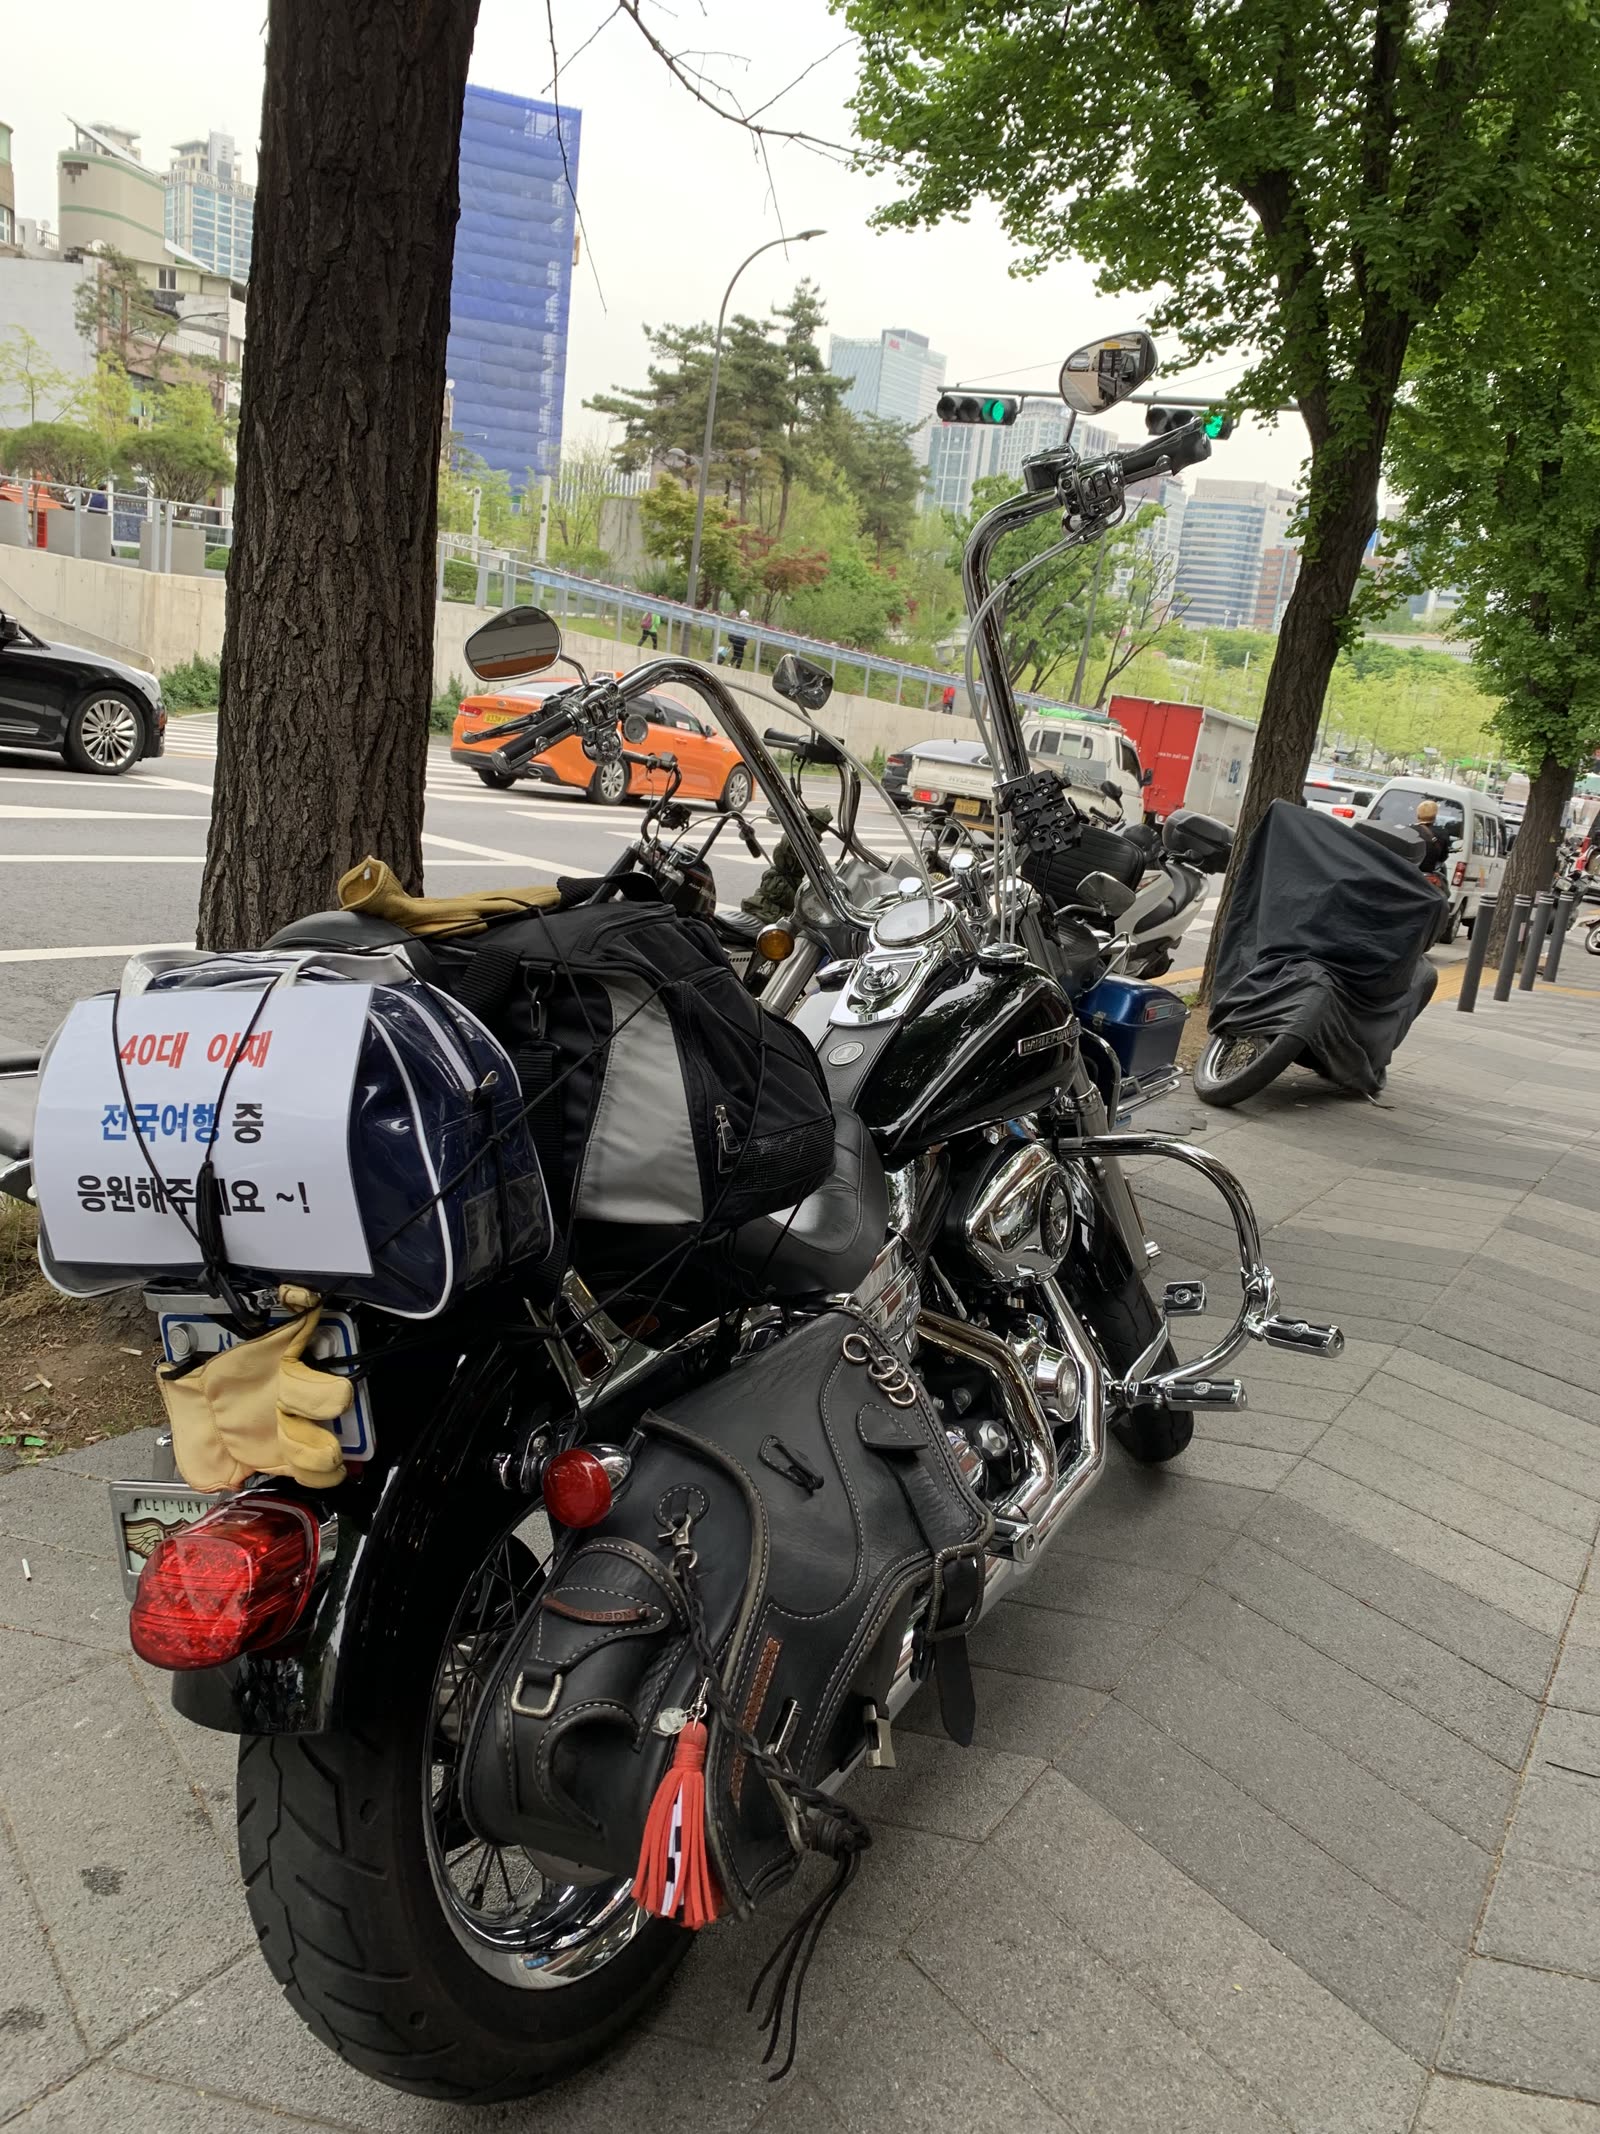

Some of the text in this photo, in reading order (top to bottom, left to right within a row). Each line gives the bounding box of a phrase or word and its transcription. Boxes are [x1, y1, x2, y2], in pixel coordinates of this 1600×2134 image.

[119, 1031, 272, 1068] 40대 아재
[101, 1103, 264, 1143] 전국여행 중
